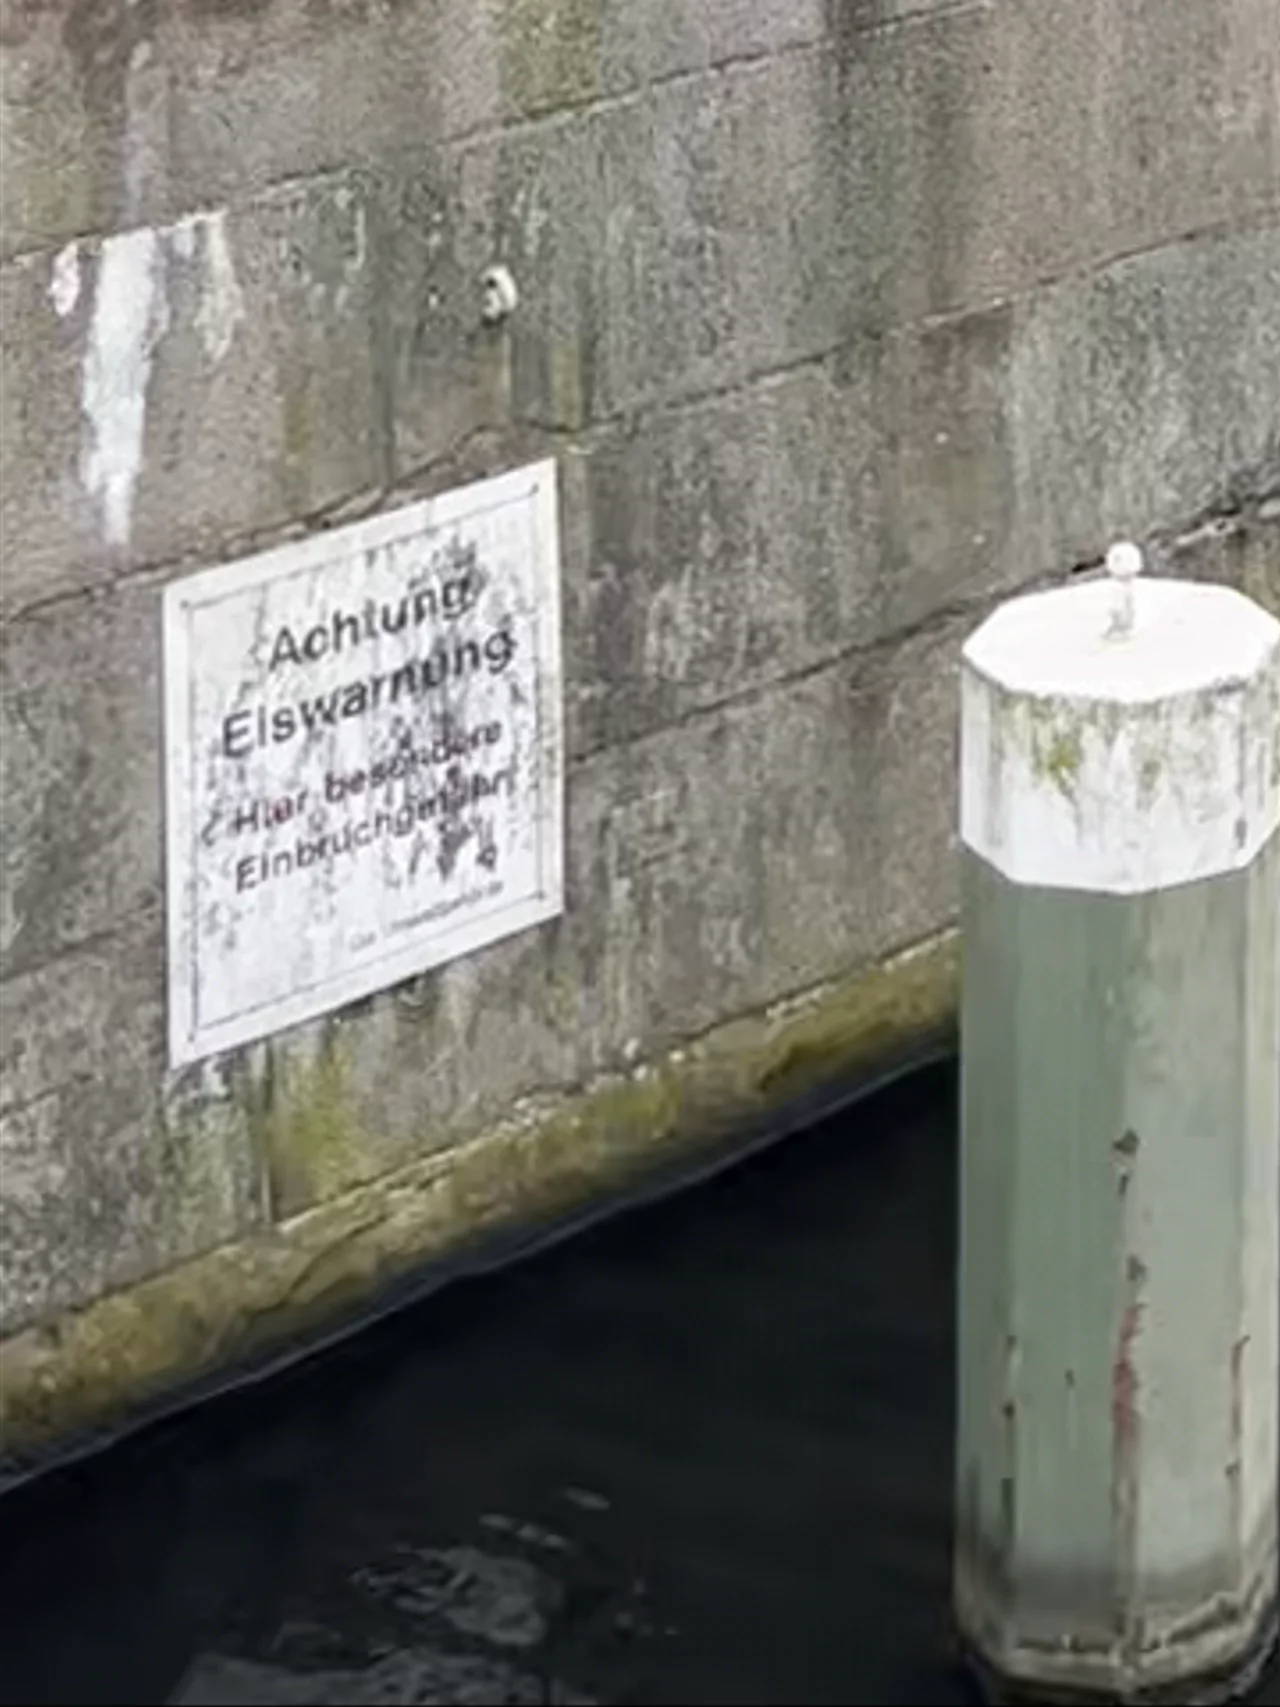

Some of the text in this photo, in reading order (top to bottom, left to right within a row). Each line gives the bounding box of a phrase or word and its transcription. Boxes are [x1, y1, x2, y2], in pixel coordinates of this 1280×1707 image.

[268, 575, 482, 671] Achtung
[221, 625, 516, 759] Eiswarnung
[234, 722, 501, 831] Hier besondere
